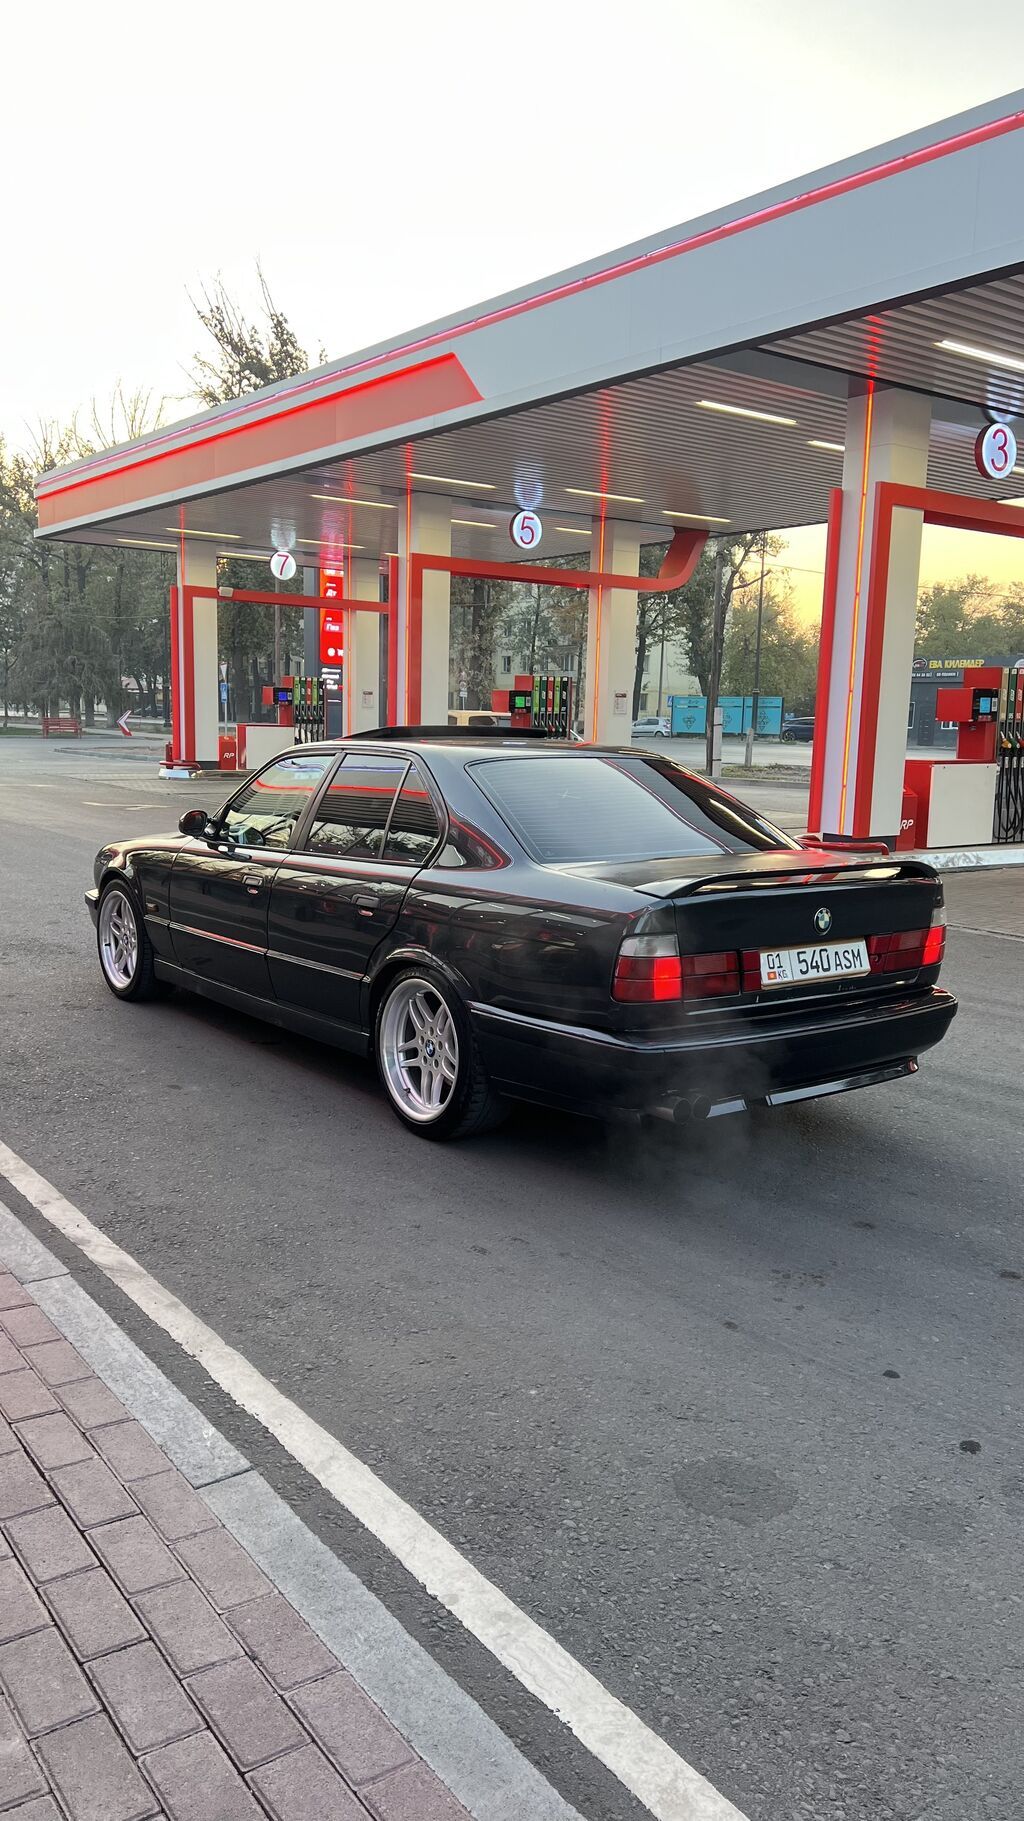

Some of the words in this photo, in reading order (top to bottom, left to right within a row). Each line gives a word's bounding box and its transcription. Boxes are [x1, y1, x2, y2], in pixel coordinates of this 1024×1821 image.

[991, 428, 1009, 472] 3
[519, 515, 535, 545] 5
[277, 553, 290, 577] 7
[766, 953, 784, 970] 01
[796, 948, 831, 975] 540
[834, 948, 863, 972] ASM
[777, 969, 788, 980] KG
